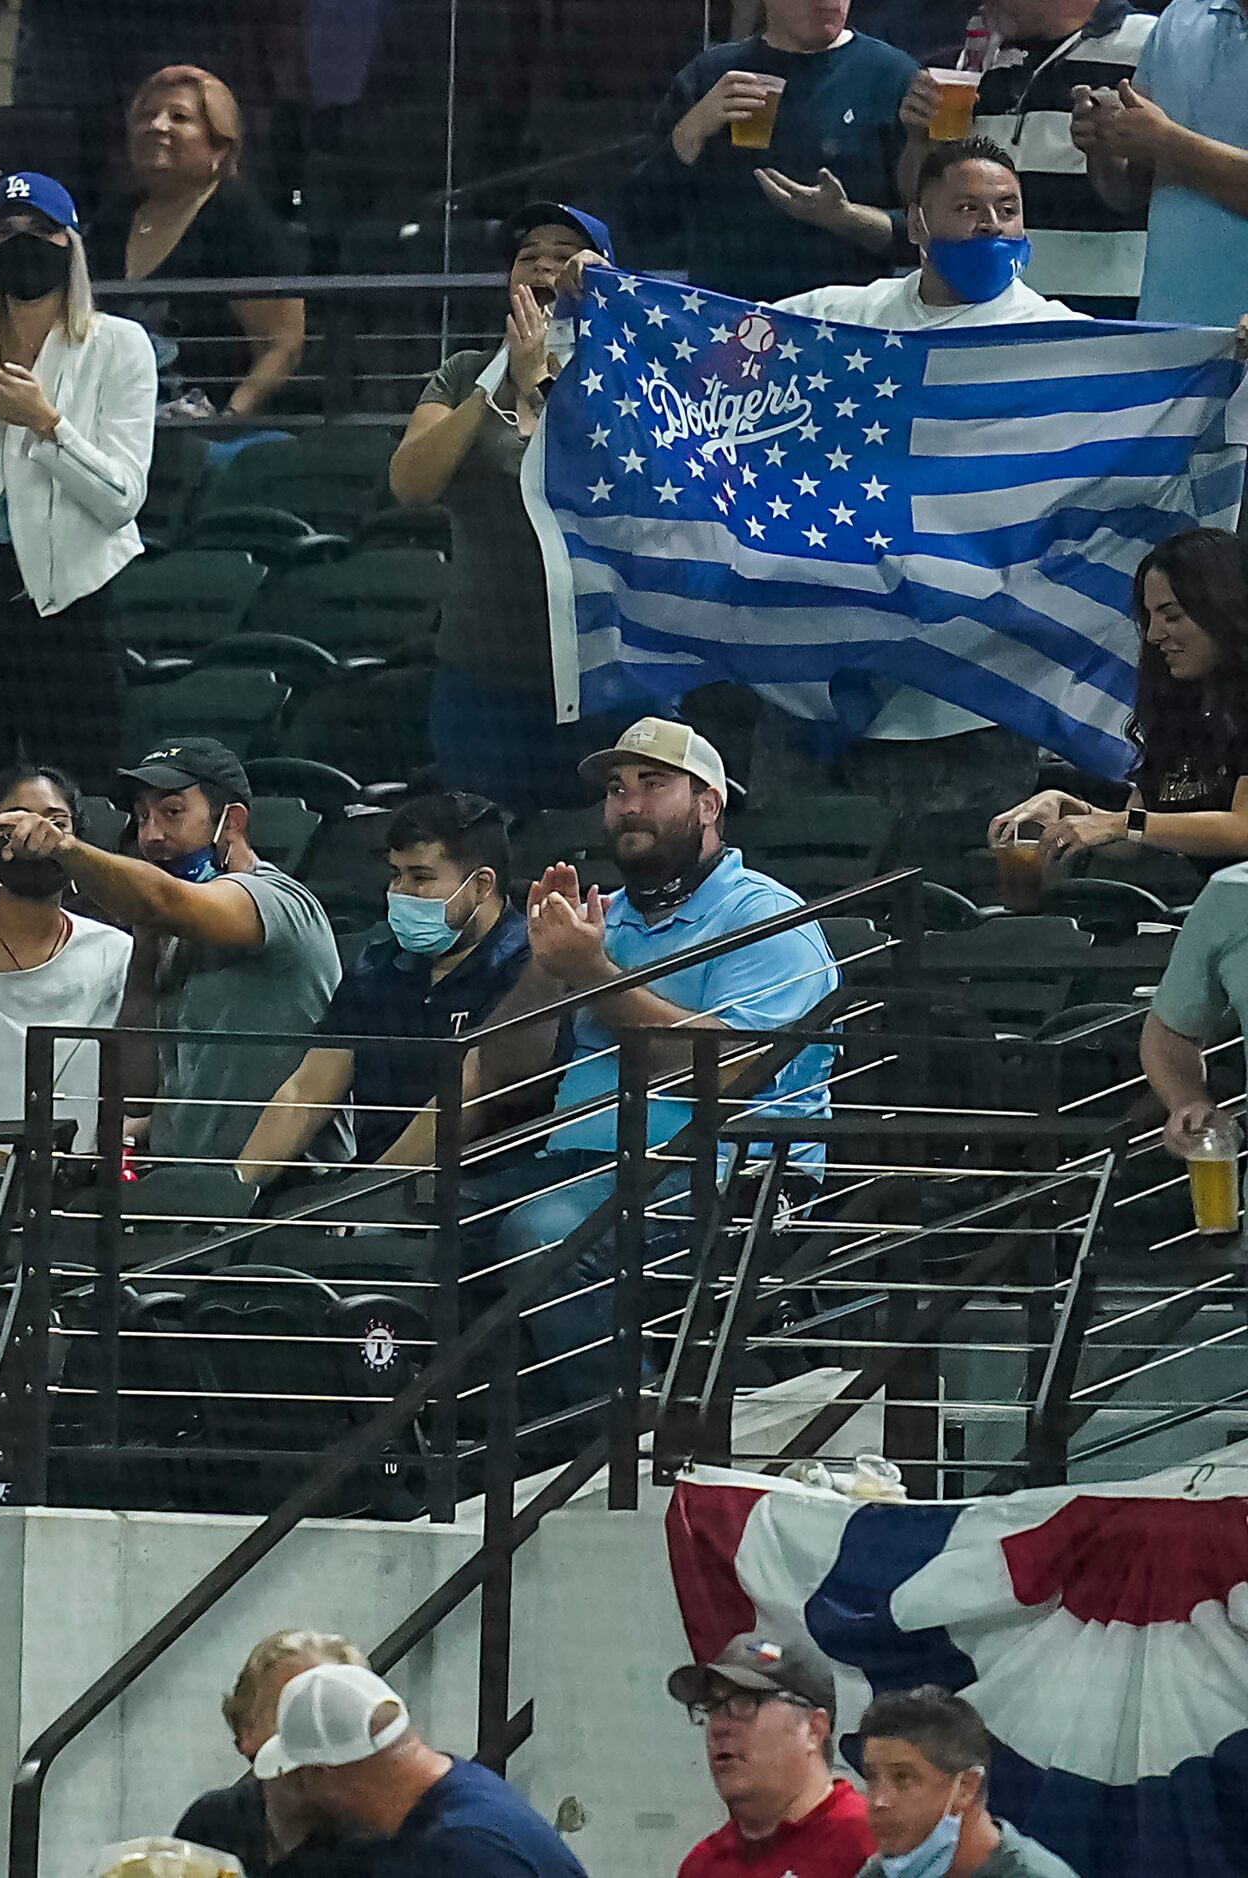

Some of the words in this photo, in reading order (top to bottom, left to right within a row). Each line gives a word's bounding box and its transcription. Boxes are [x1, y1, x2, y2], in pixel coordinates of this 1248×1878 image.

[5, 176, 30, 198] LA
[648, 374, 812, 465] Dodgers
[450, 1011, 469, 1036] T
